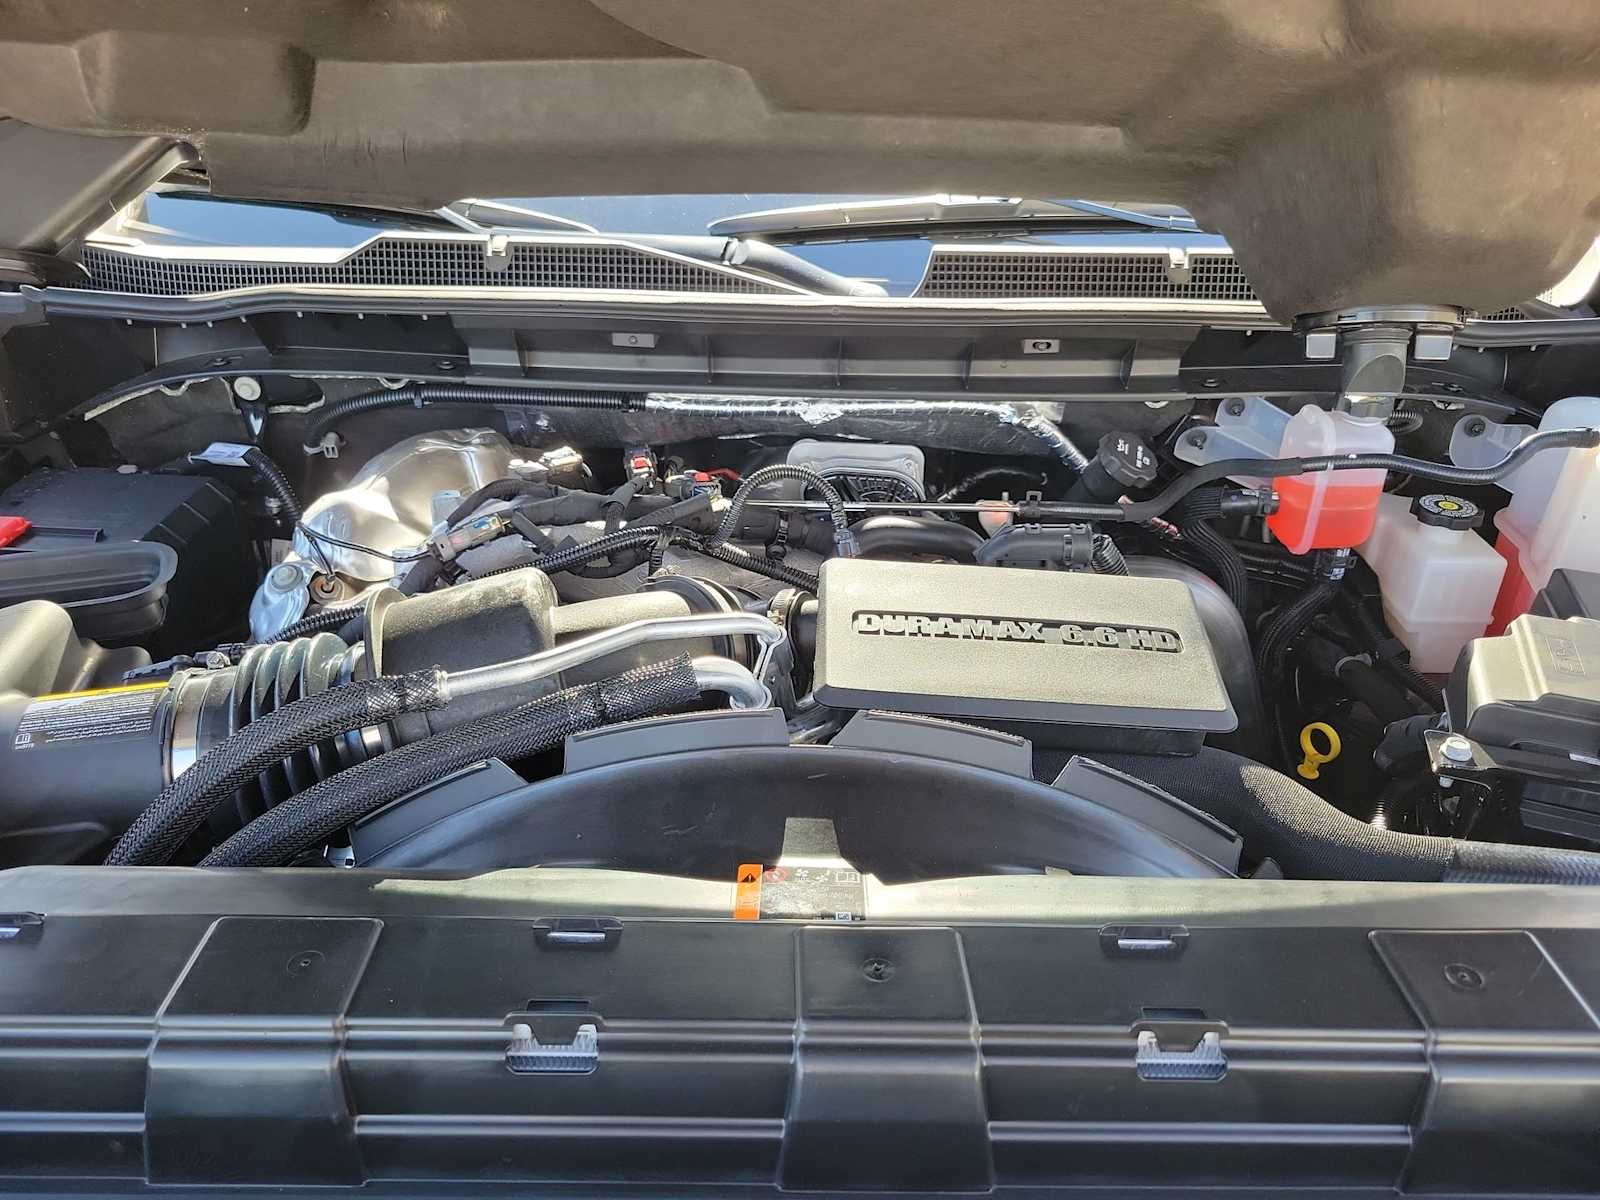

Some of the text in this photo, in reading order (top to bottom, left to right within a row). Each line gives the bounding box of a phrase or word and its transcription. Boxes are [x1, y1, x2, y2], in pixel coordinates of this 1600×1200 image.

[857, 613, 1180, 651] DURAMAX 6.6 HD
